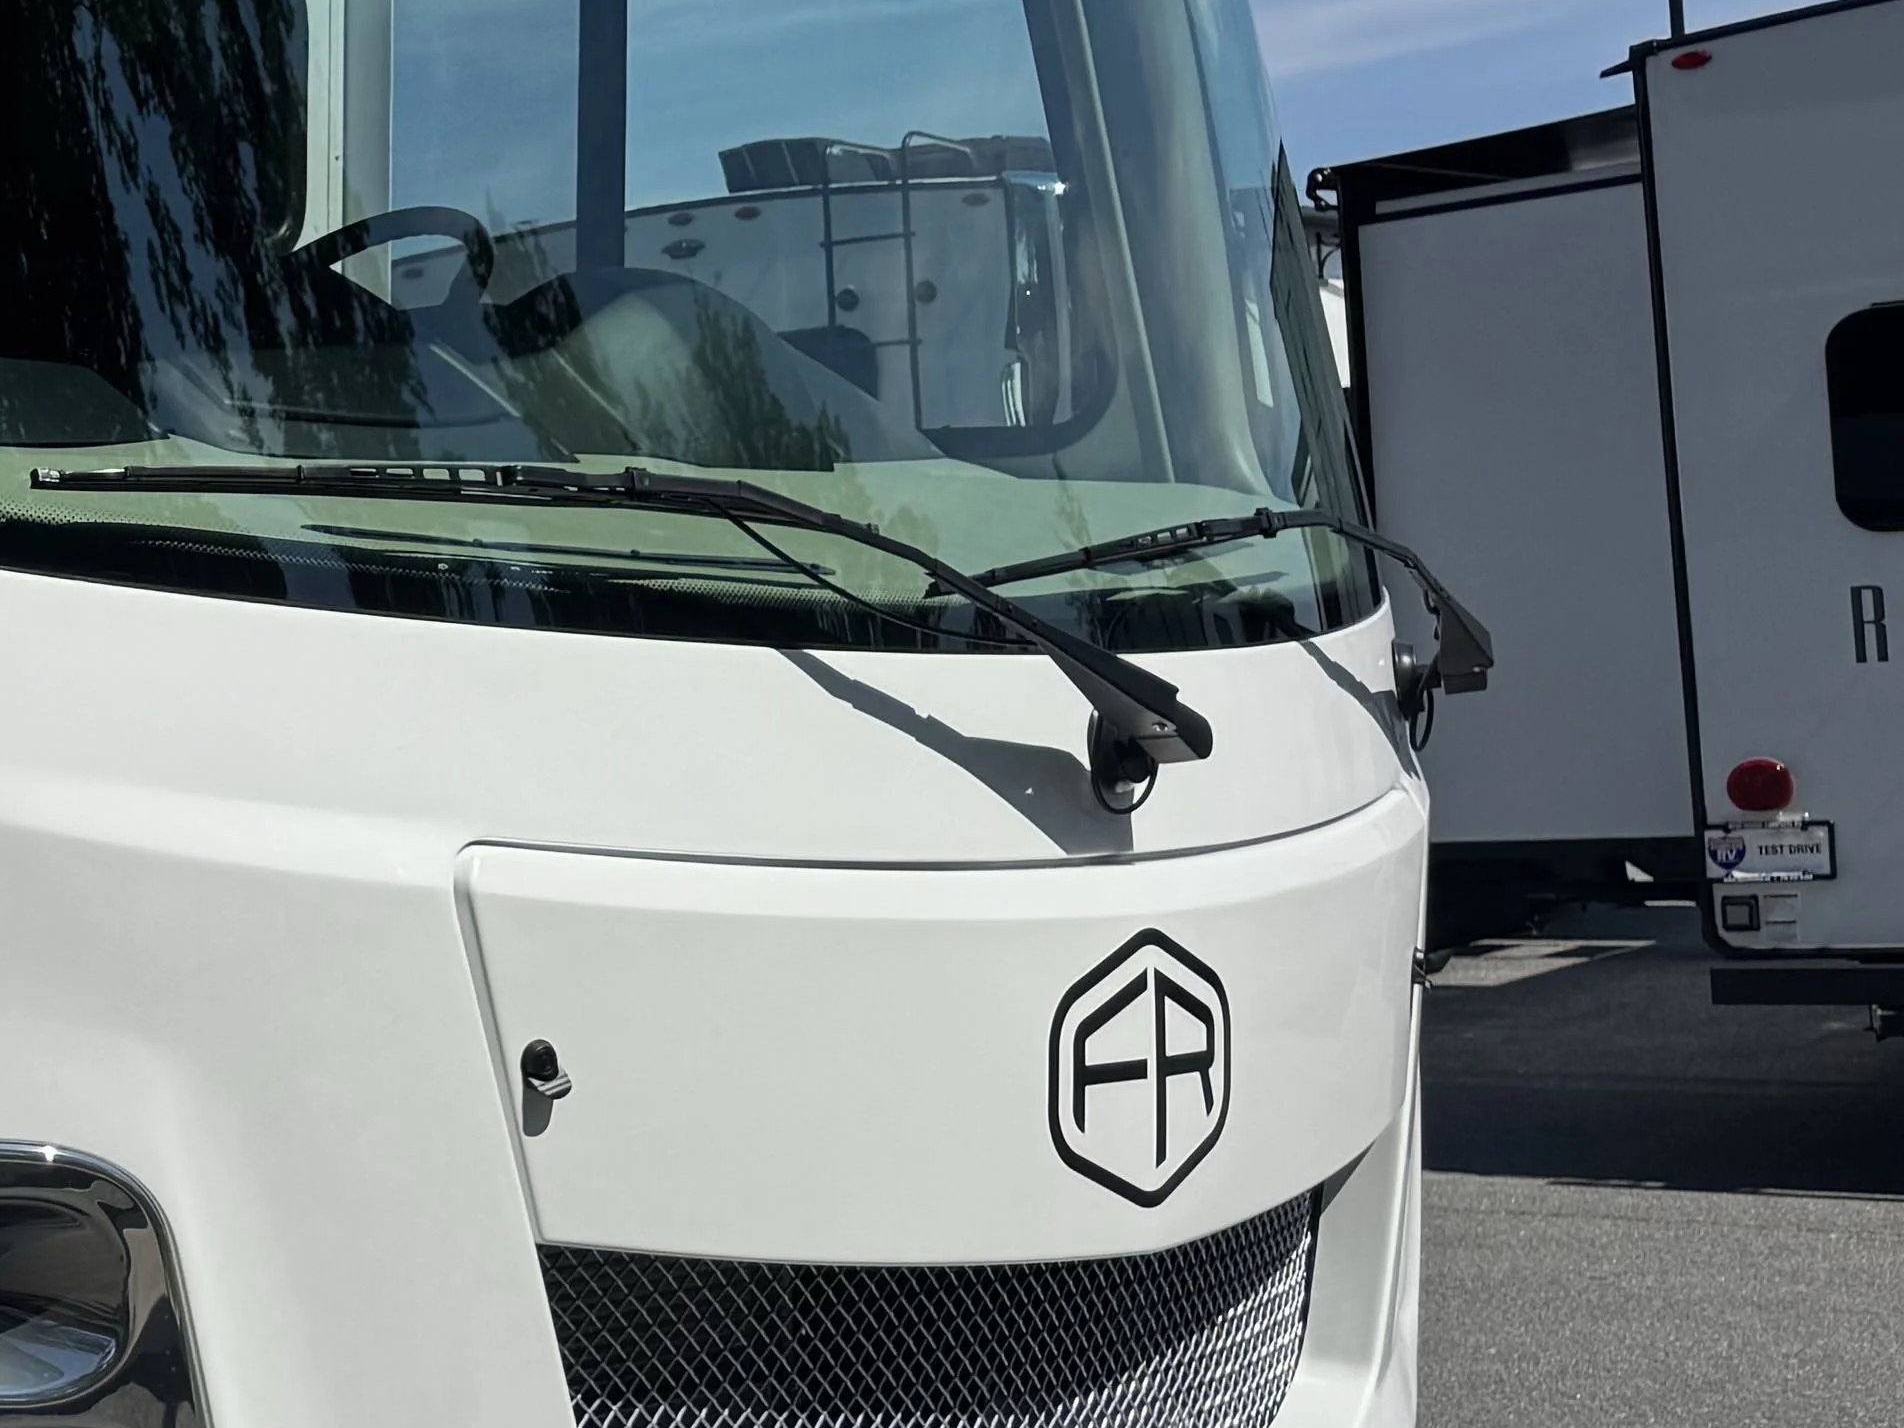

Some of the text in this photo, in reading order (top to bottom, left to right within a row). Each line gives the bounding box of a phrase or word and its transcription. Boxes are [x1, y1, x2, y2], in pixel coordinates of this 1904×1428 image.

[1850, 584, 1889, 663] R
[1757, 843, 1786, 857] TEST
[1789, 842, 1822, 855] DRIVE
[1073, 967, 1215, 1169] FR
